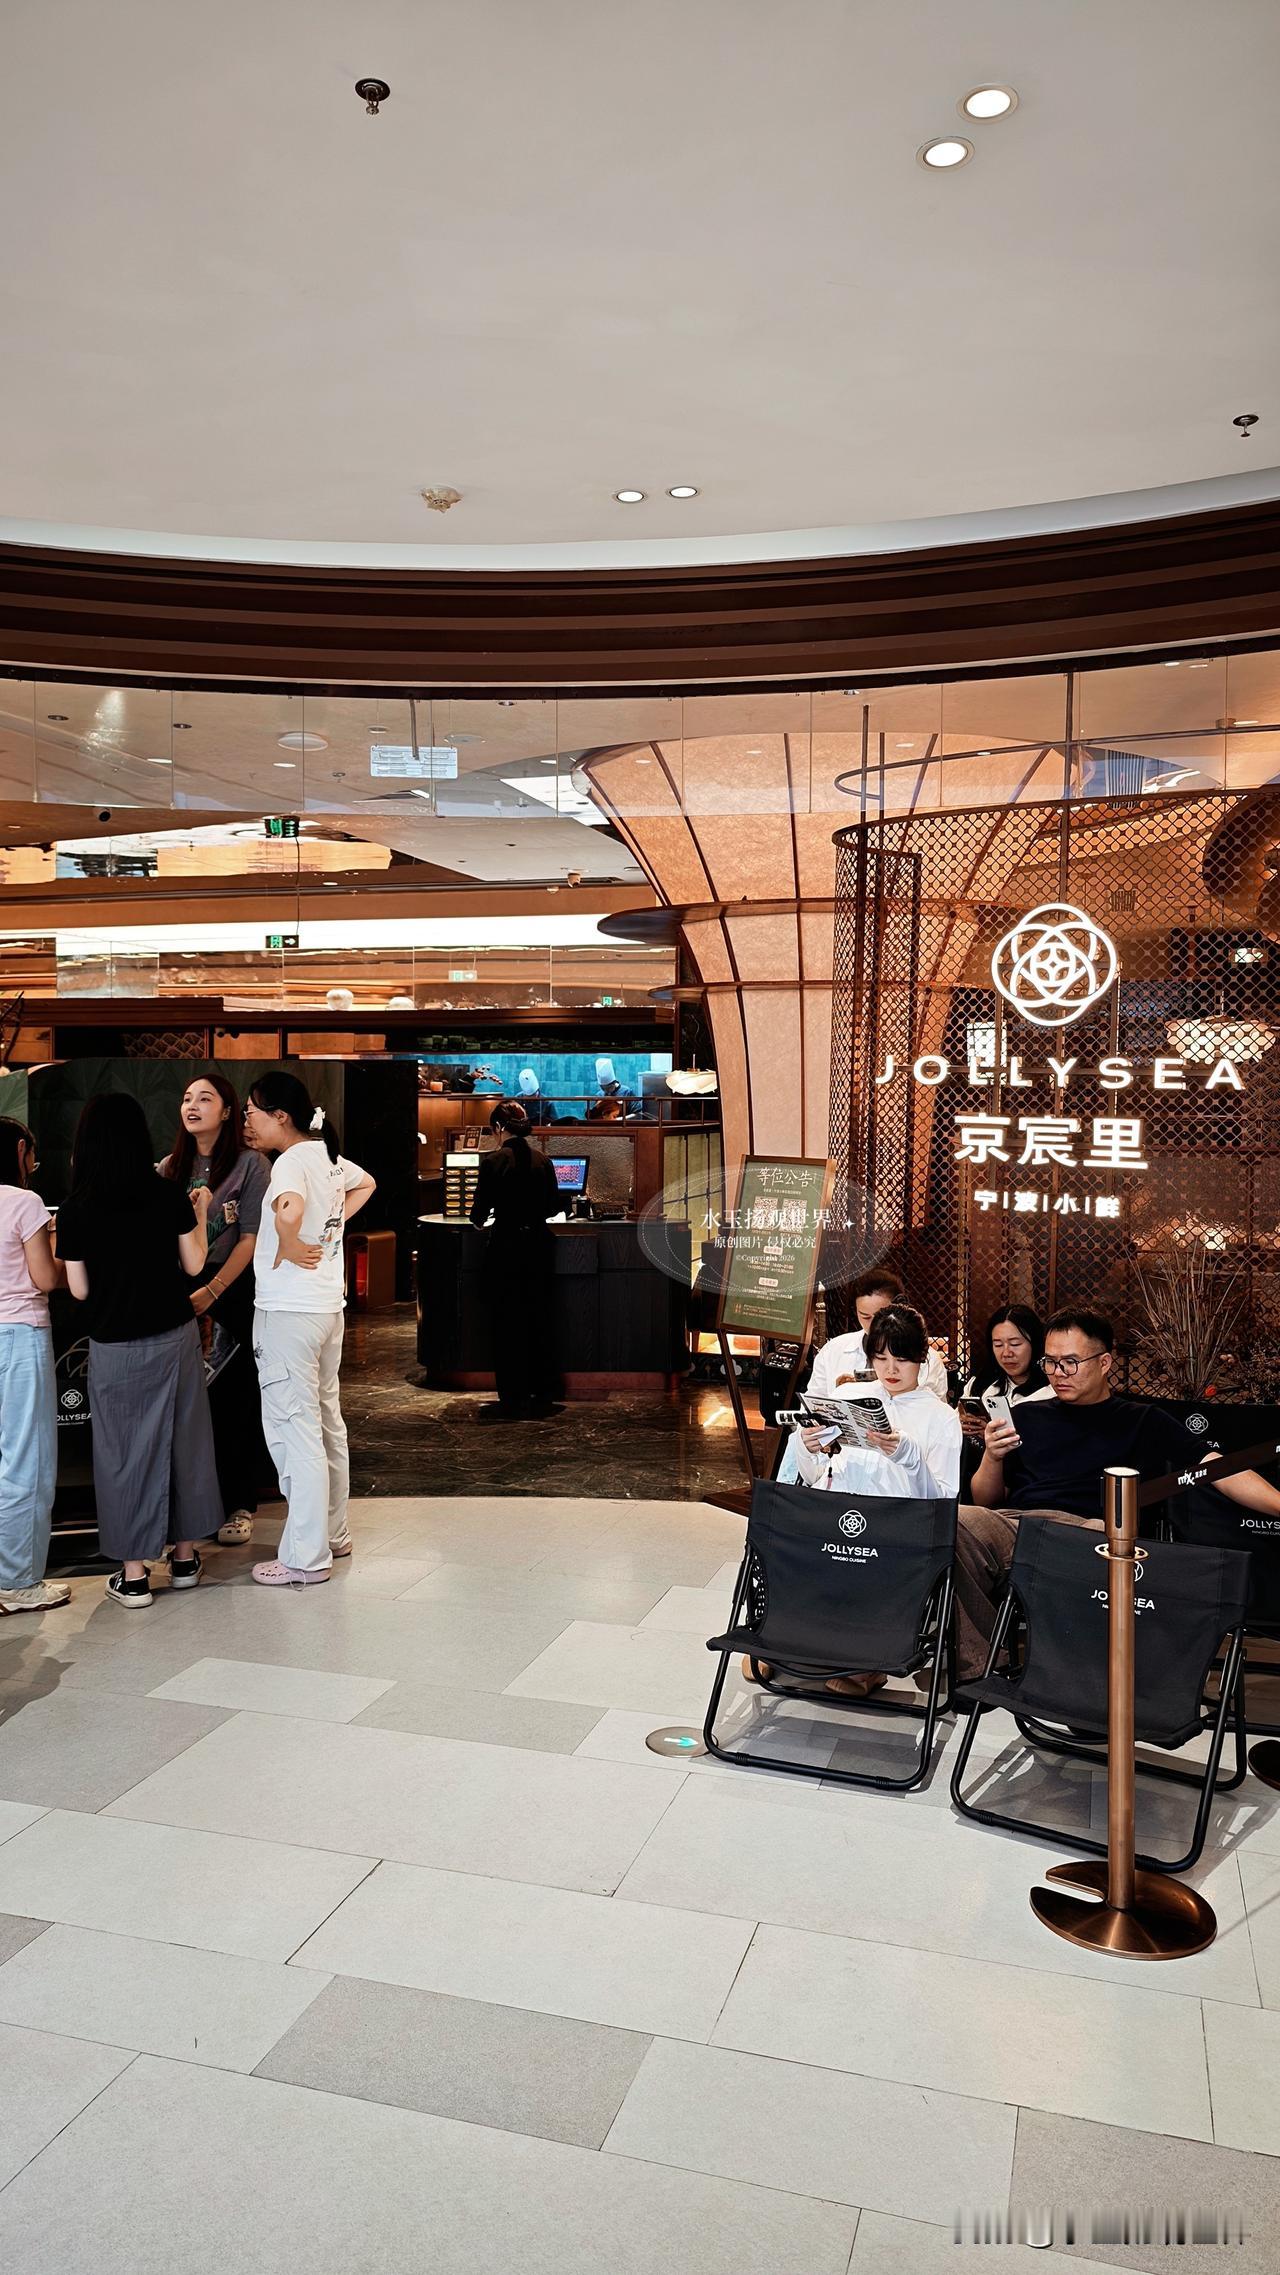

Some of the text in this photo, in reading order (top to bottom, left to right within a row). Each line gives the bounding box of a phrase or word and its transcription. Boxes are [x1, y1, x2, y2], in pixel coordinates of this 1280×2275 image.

[954, 1113, 1149, 1169] 京宸里
[757, 1167, 813, 1187] 等位公告
[821, 1543, 878, 1557] JOLLYSEA
